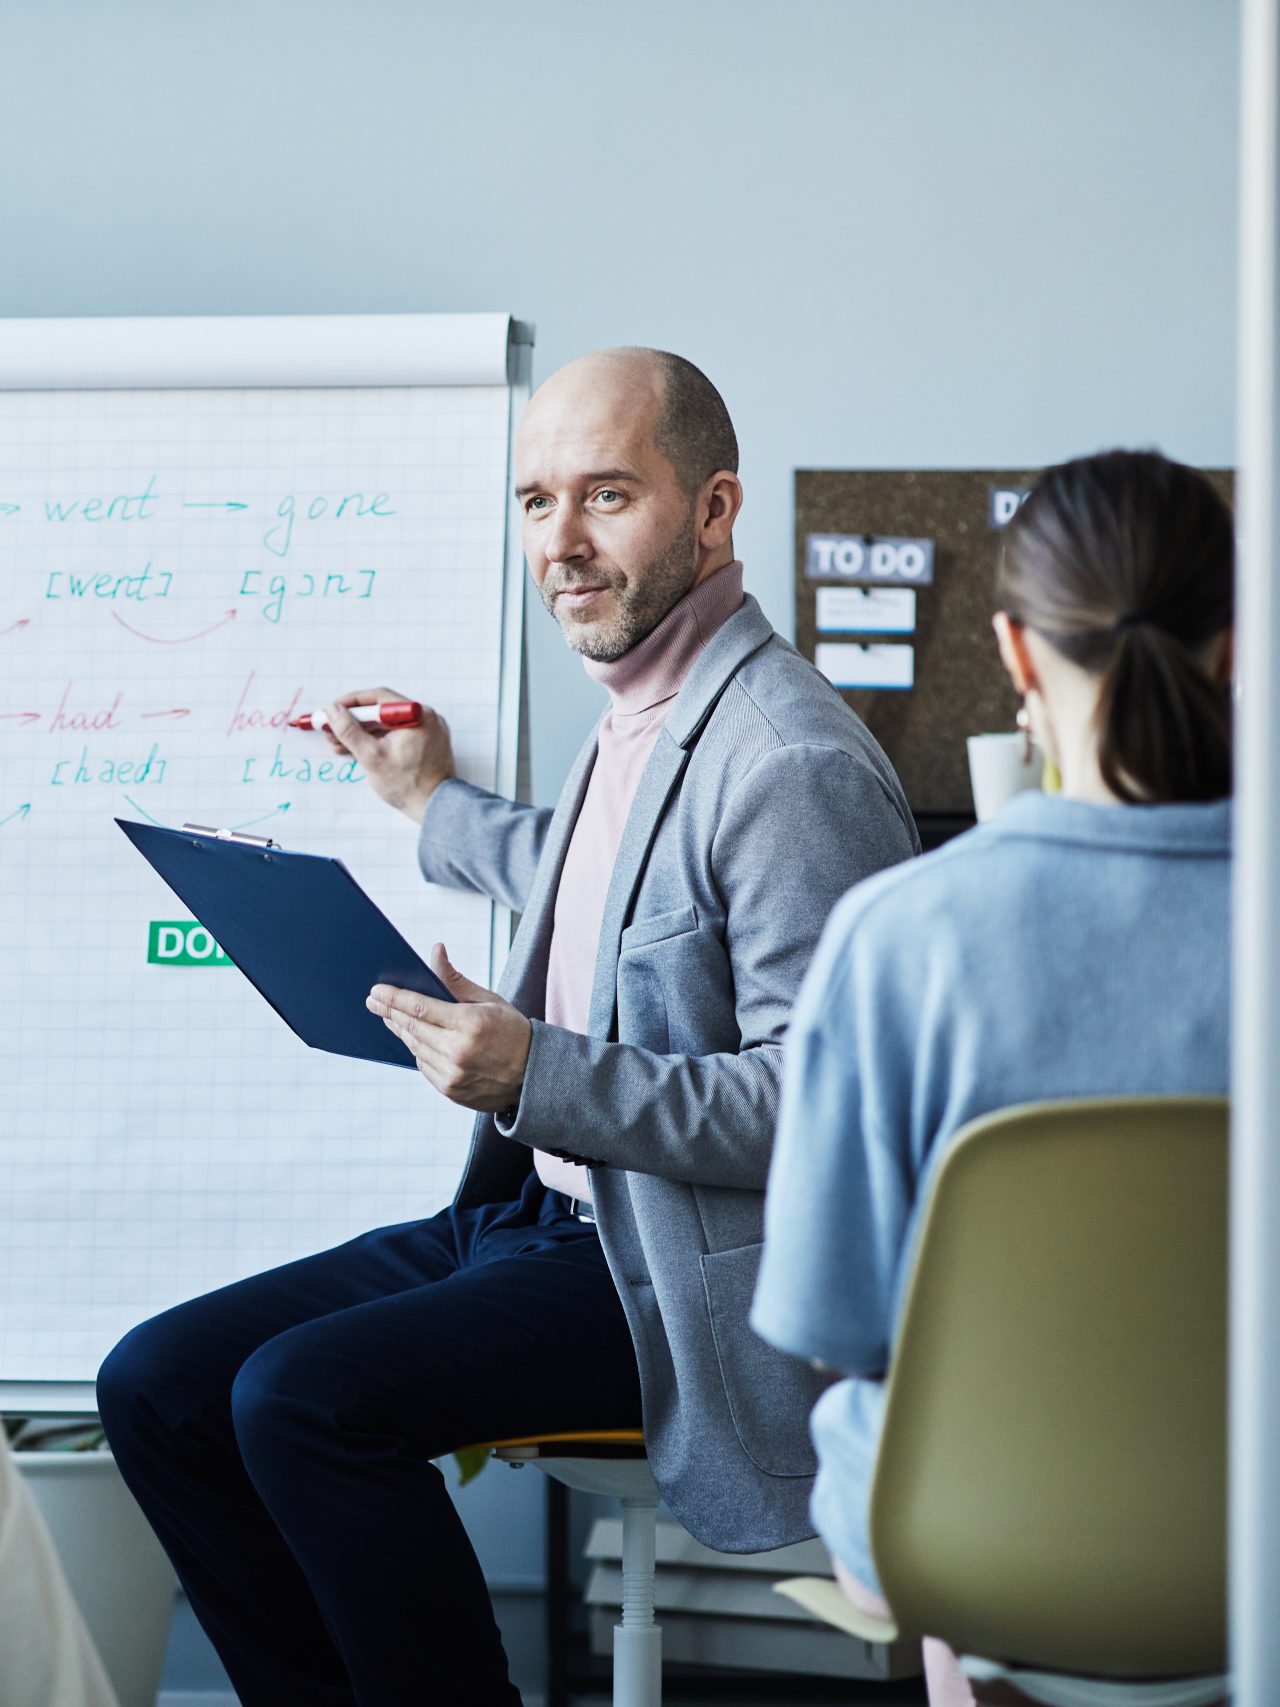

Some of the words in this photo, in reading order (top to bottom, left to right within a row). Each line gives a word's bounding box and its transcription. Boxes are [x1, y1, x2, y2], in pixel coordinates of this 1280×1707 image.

[45, 474, 159, 522] went
[263, 492, 398, 557] gone
[993, 490, 1032, 525] D
[812, 540, 864, 575] TO
[870, 543, 926, 579] DO
[48, 678, 125, 734] had
[227, 669, 304, 738] had
